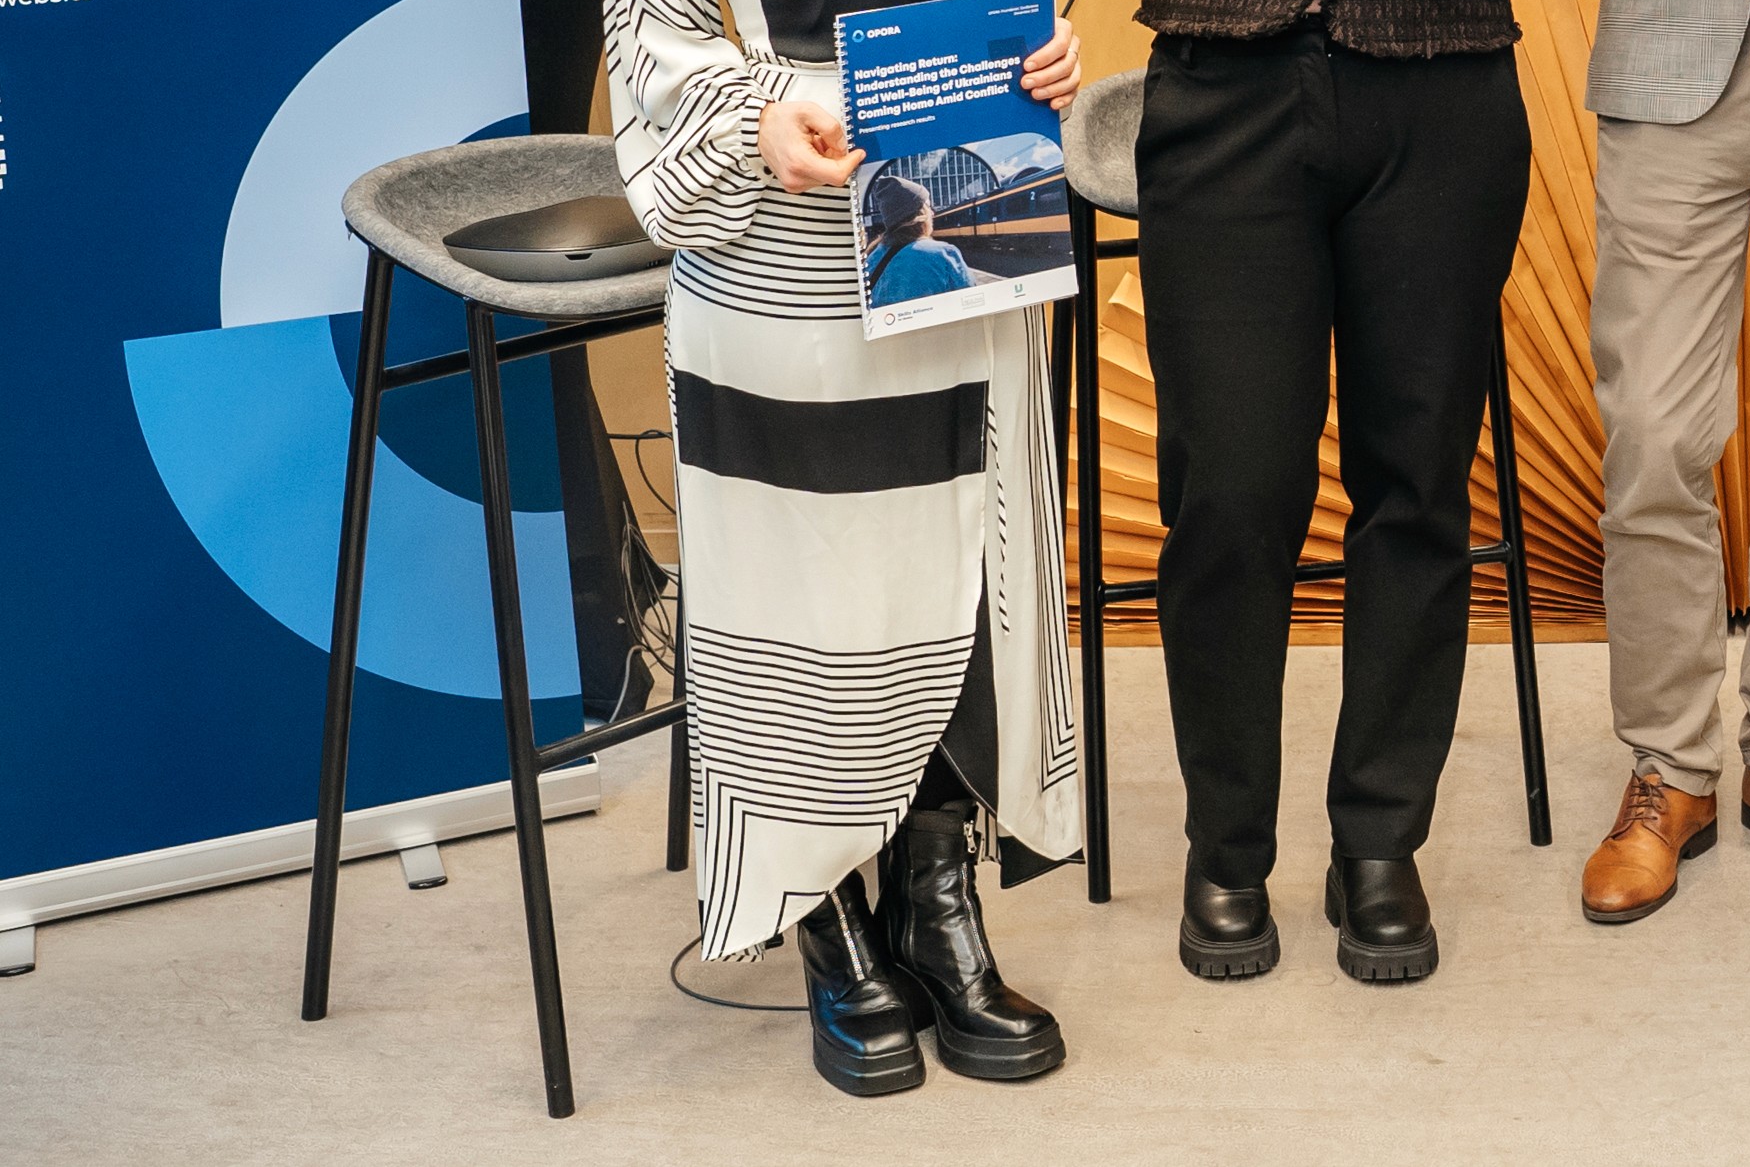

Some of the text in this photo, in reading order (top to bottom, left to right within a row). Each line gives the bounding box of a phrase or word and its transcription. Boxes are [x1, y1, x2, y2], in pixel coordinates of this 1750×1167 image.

[867, 26, 901, 38] OPORA
[855, 55, 958, 79] Navigating Return:
[856, 57, 1020, 93] Understanding the Challenges
[857, 71, 1012, 106] and Well-Being of Ukrainians
[858, 84, 1009, 120] Coming Home Amid Conflict
